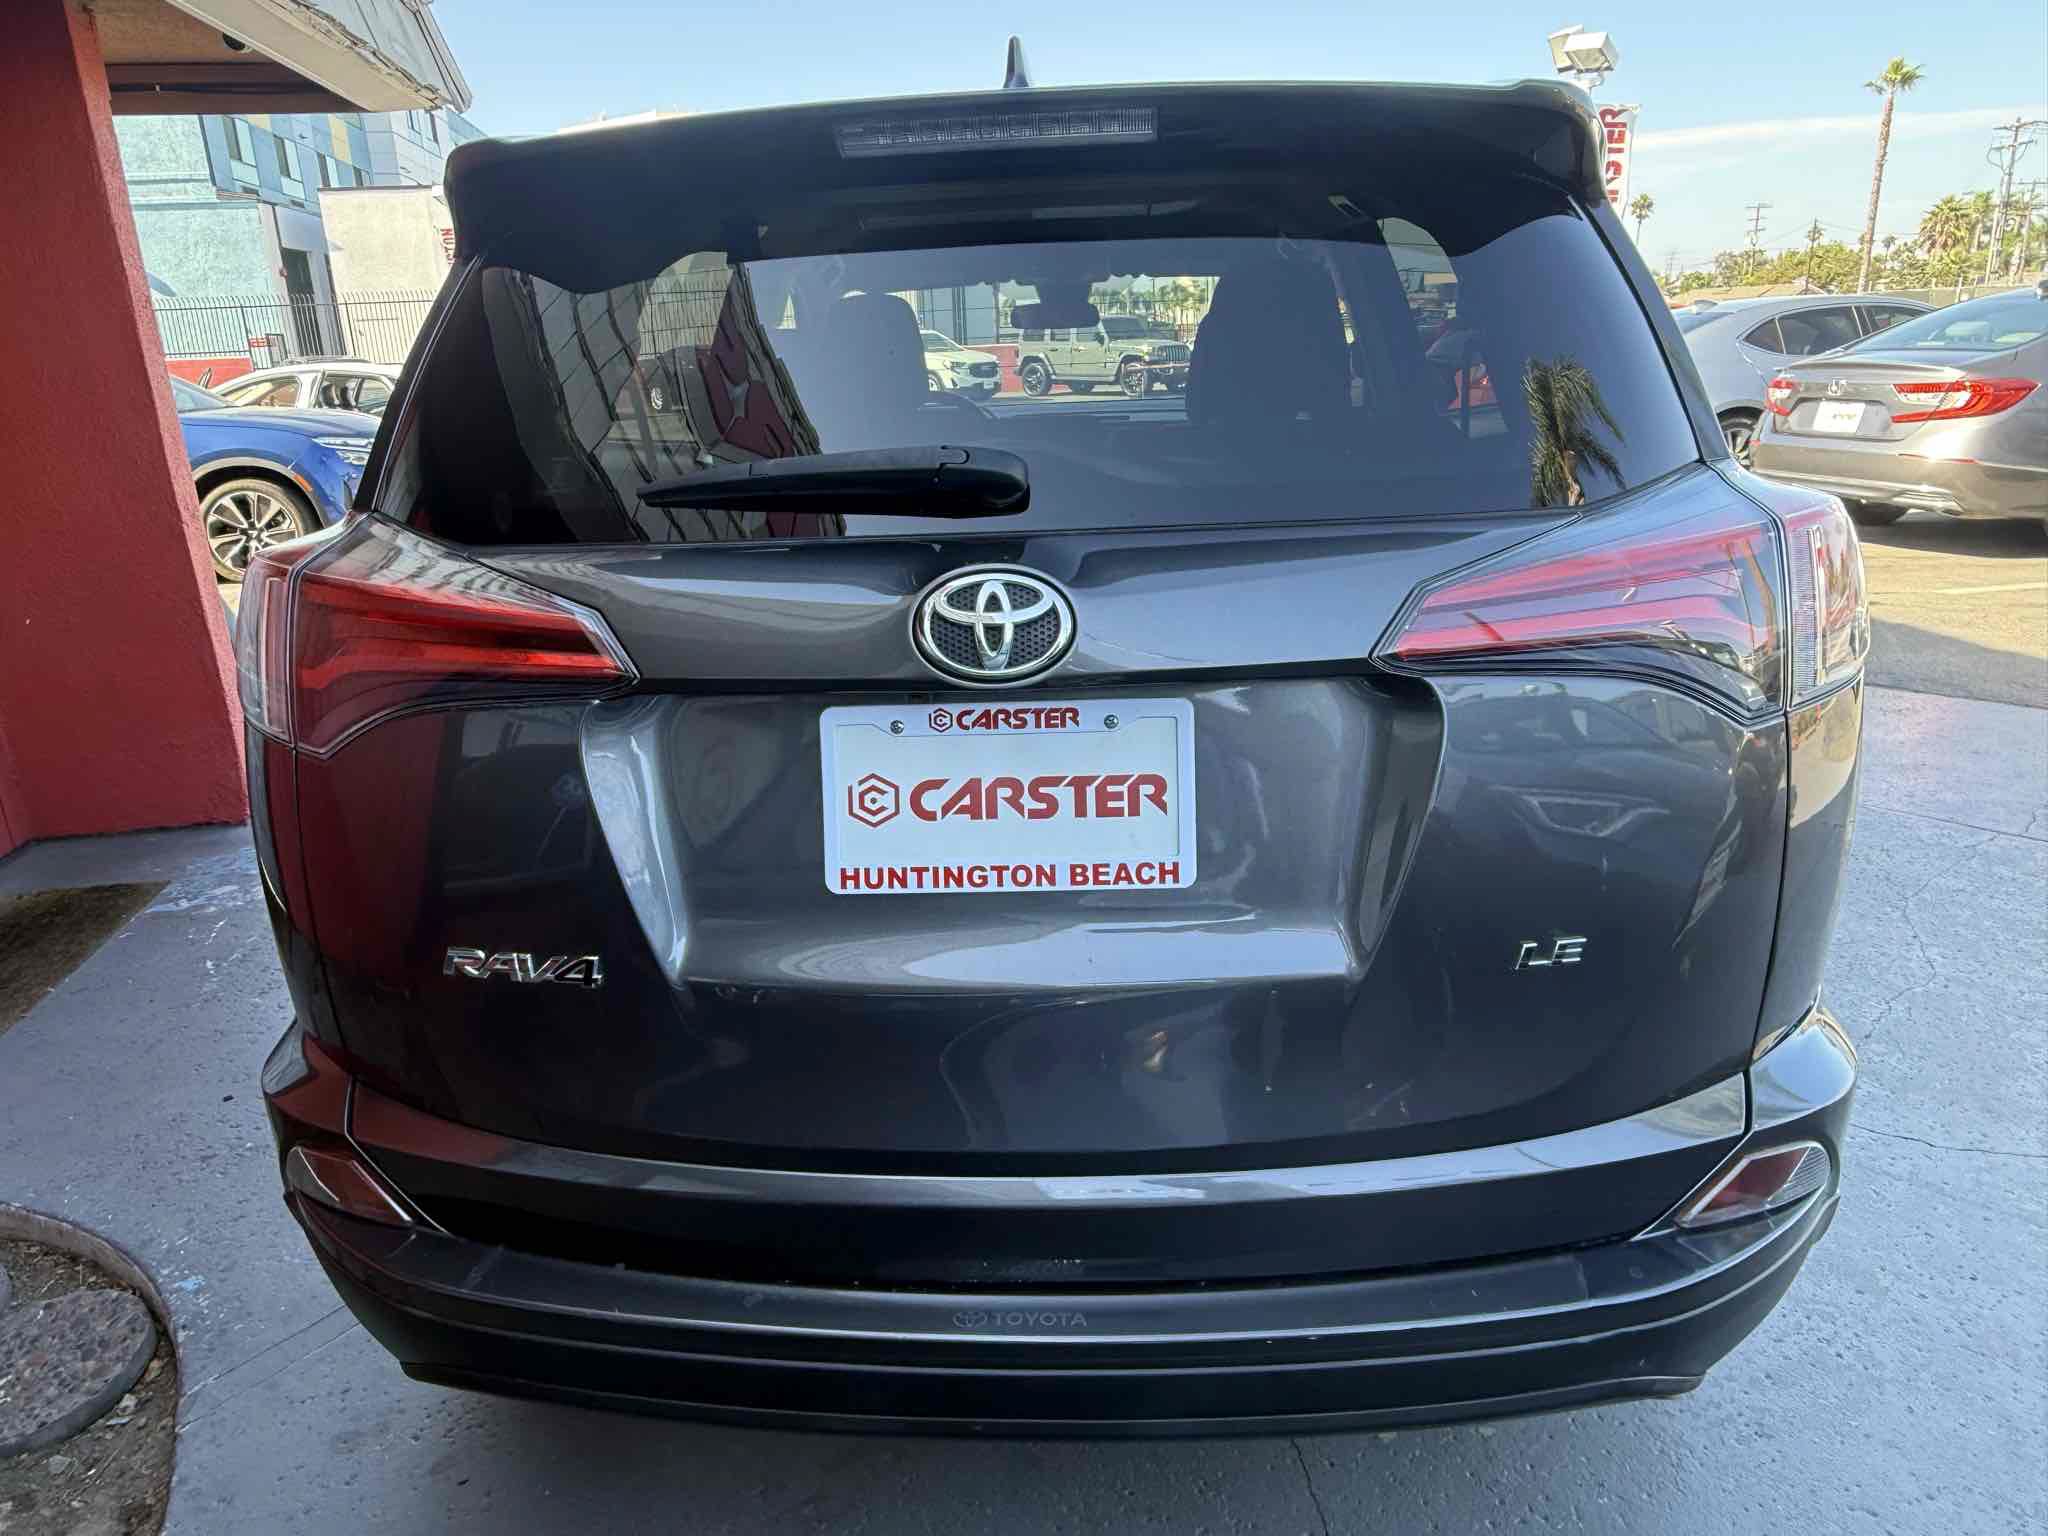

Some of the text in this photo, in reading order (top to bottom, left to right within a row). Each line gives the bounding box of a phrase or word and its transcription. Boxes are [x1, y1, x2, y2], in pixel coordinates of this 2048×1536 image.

[956, 708, 1080, 731] CARSTER
[909, 774, 1169, 821] CARSTER
[840, 862, 1181, 890] HUNTINGTON BEACH
[443, 947, 602, 988] RAV4
[1515, 937, 1587, 970] LE
[991, 1311, 1087, 1327] TOYOTA
